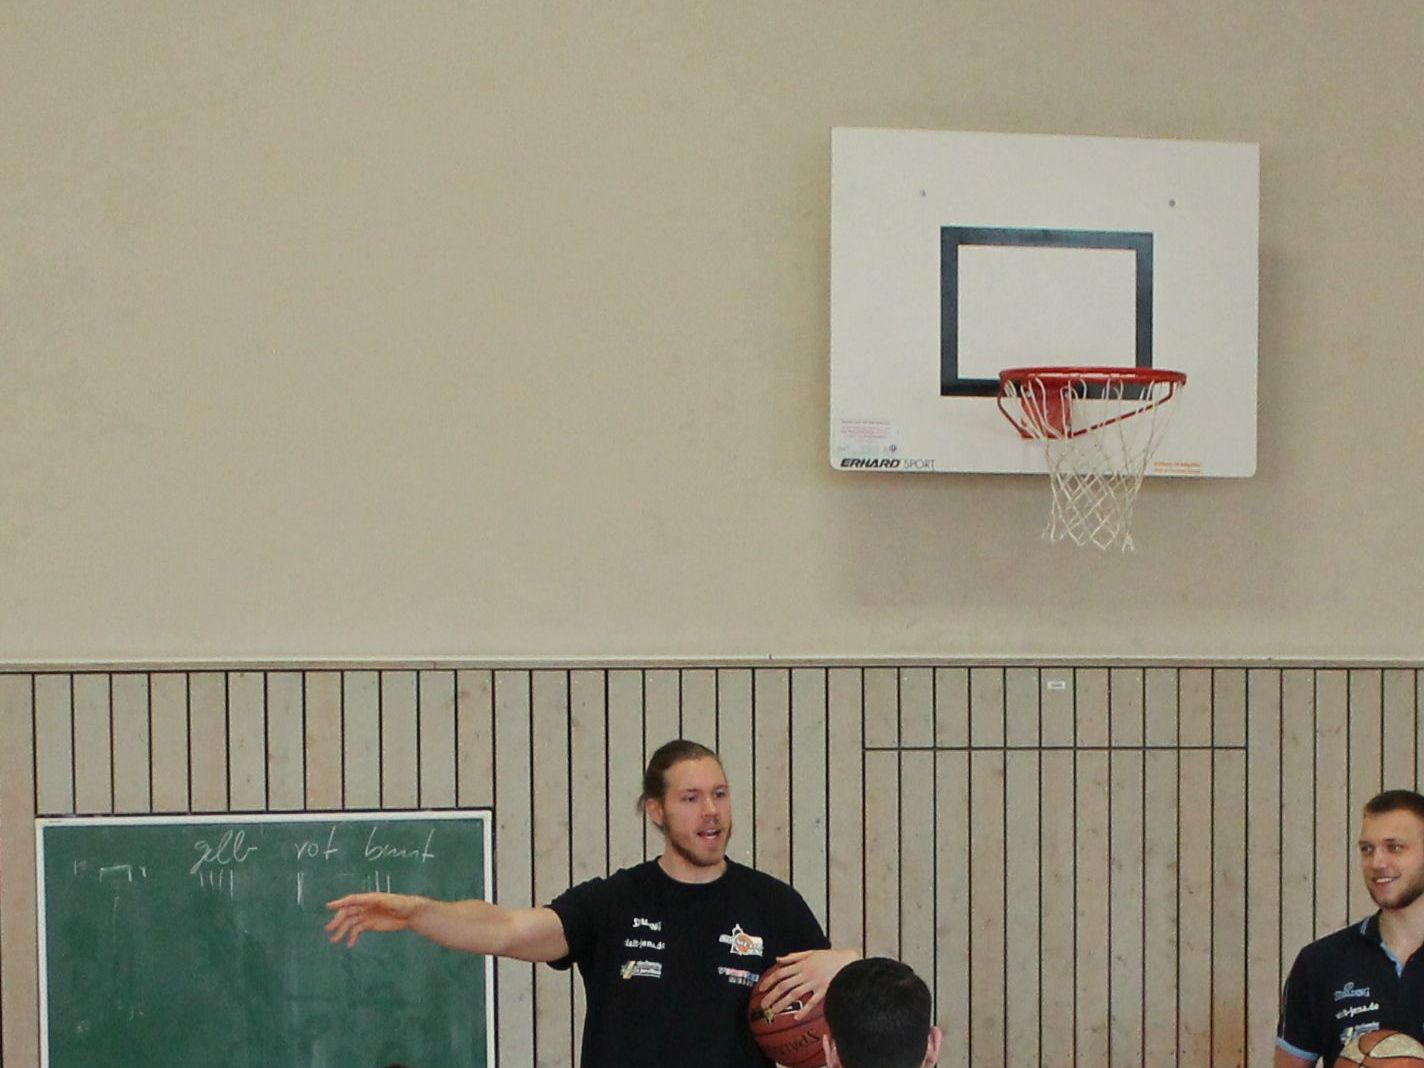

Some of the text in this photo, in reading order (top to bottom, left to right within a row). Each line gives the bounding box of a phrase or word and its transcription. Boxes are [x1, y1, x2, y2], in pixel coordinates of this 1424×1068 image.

[840, 458, 935, 470] ERHARD SPORT
[190, 829, 258, 875] gelb
[295, 826, 338, 861] rot
